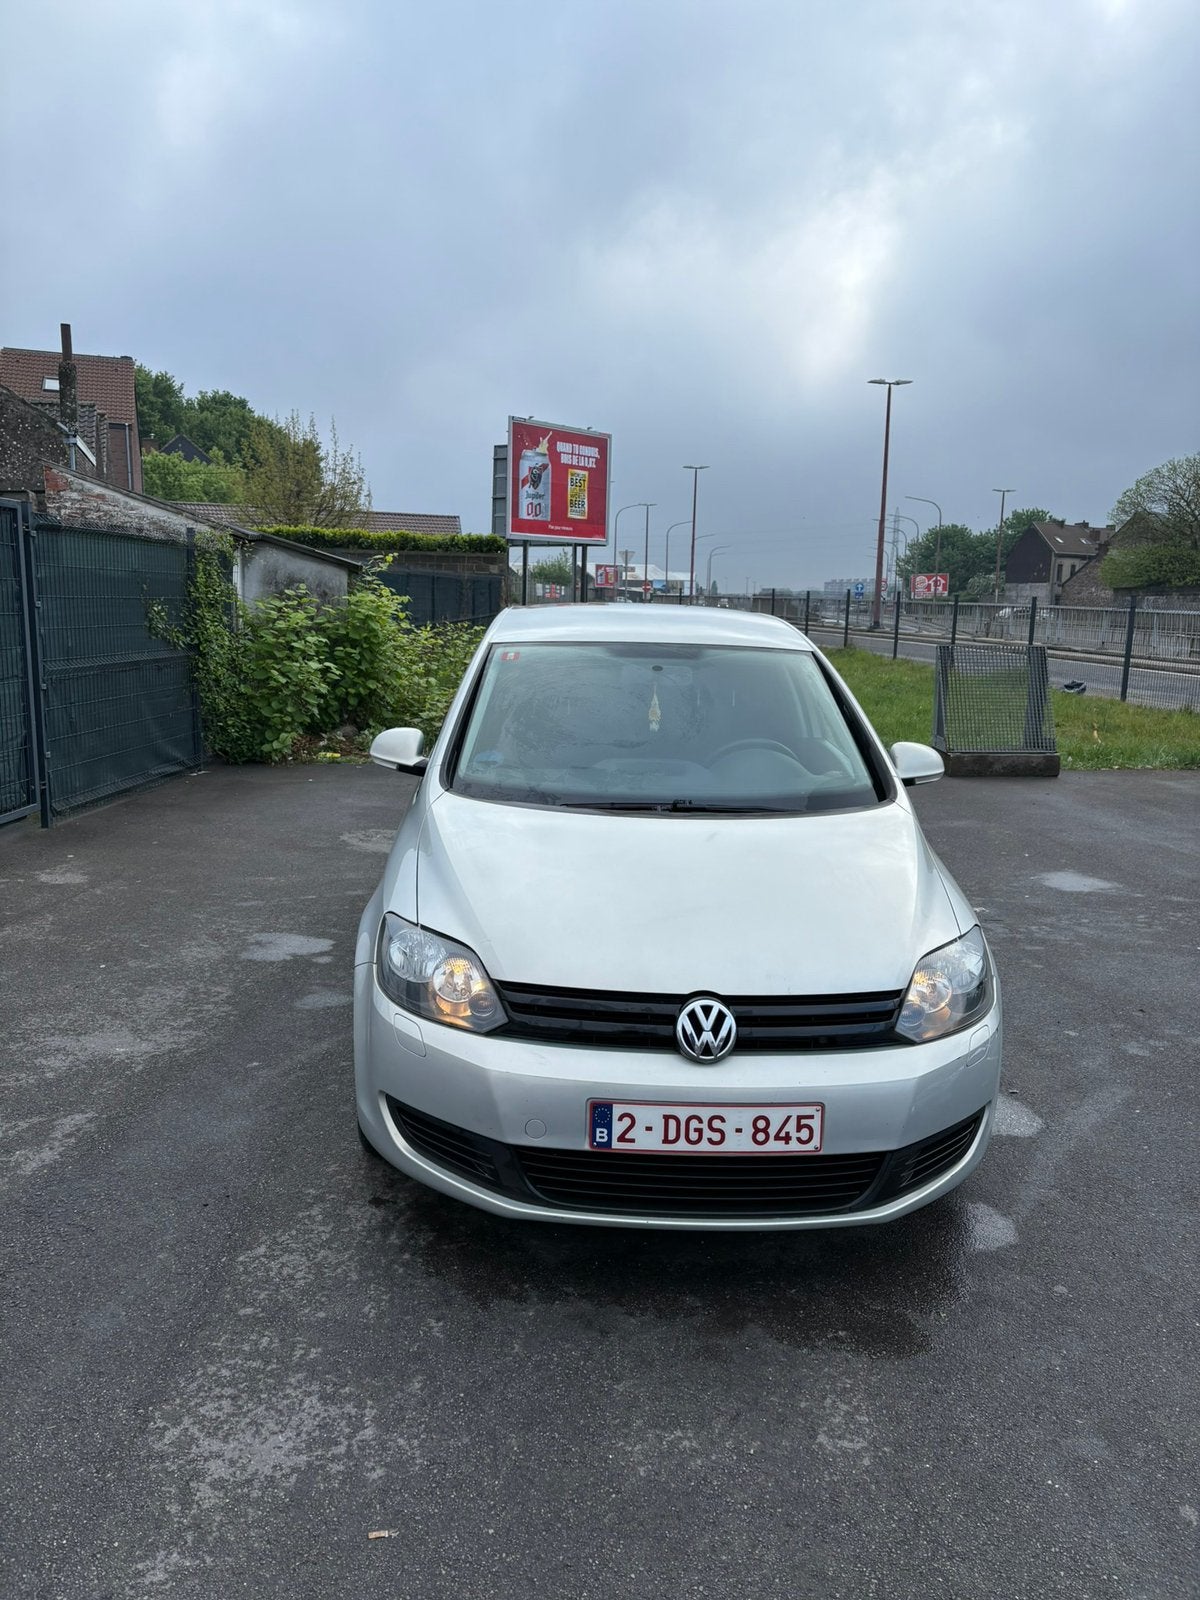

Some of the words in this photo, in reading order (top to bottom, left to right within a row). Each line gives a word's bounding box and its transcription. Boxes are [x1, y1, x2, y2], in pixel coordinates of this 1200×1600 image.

[570, 477, 586, 488] BEST
[570, 499, 586, 509] BEER
[676, 998, 736, 1060] VW
[595, 1127, 608, 1143] B
